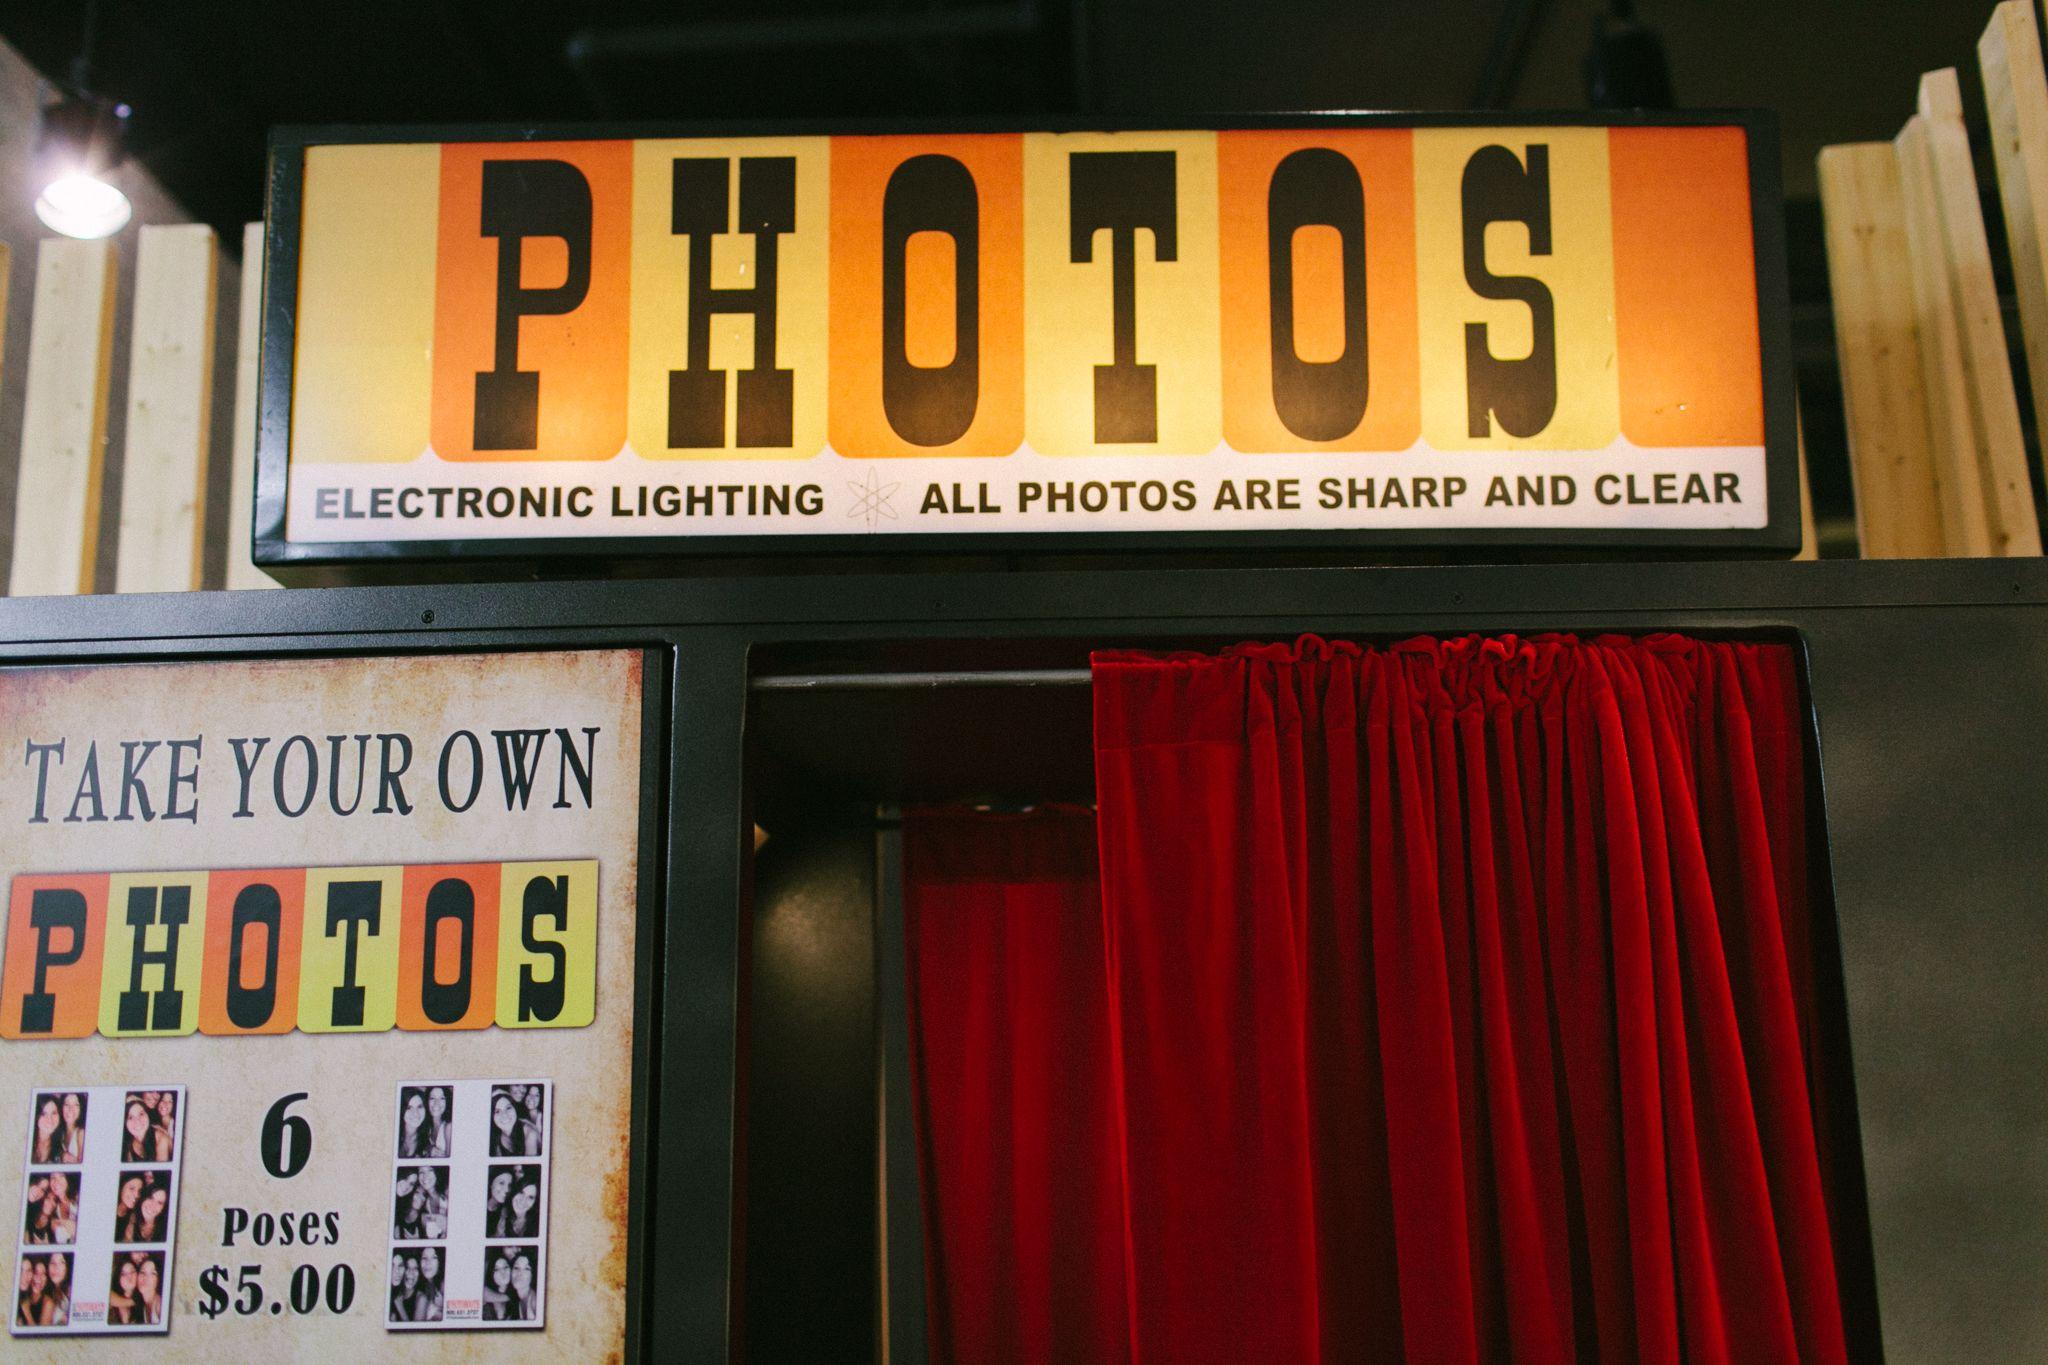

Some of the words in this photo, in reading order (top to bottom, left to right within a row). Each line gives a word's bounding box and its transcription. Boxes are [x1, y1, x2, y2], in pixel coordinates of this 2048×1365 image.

[473, 143, 1558, 451] PHOTOS
[315, 486, 594, 520] ELECTRONIC
[611, 483, 824, 517] LIGHTING
[919, 482, 1001, 515] ALL
[1018, 480, 1197, 514] PHOTOS
[1213, 479, 1301, 511] ARE
[1318, 477, 1467, 510] SHARP
[1484, 475, 1577, 507] AND
[1594, 472, 1742, 506] CLEAR
[26, 734, 203, 825] TAKE
[227, 733, 414, 818] YOUR
[437, 726, 601, 814] OWN
[20, 875, 569, 1034] PHOTOS
[260, 1092, 312, 1179] 6
[221, 1207, 340, 1247] Poses
[198, 1263, 356, 1320] $5.00
